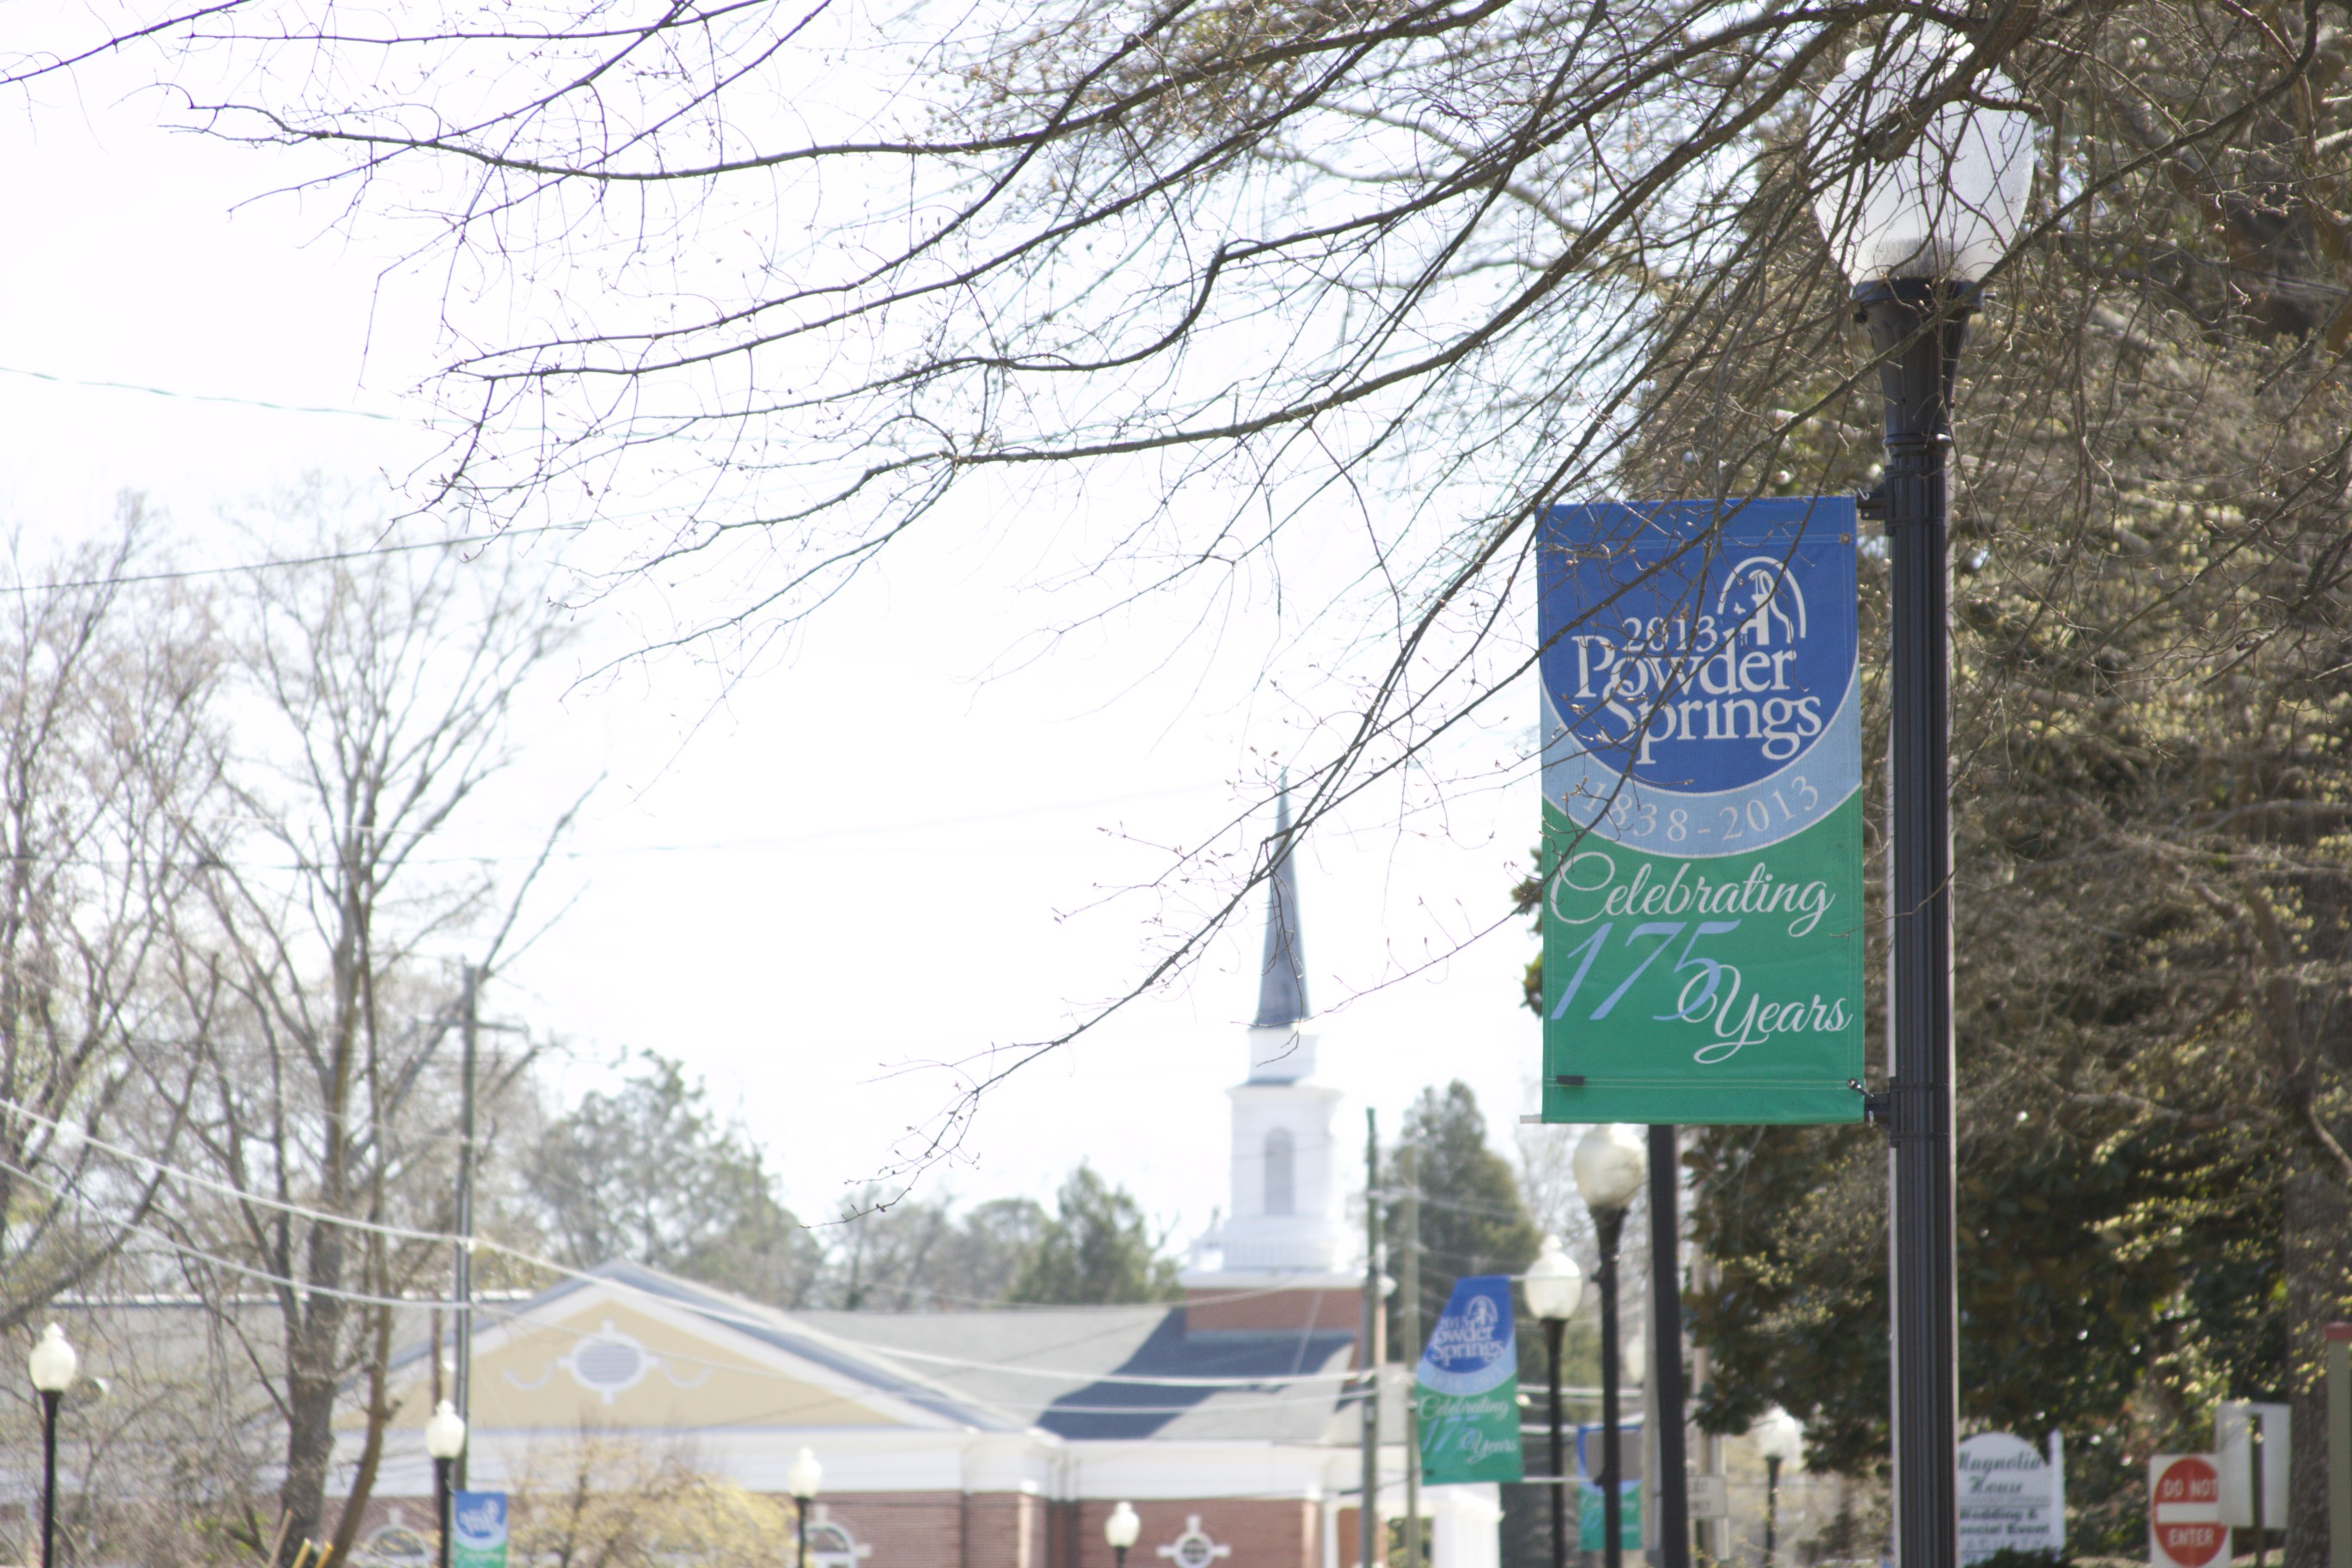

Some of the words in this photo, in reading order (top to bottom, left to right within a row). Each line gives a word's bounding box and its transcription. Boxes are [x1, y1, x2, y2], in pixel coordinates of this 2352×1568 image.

[1622, 615, 1719, 653] 2013
[1571, 626, 1798, 700] Powder
[1600, 677, 1822, 764] Springs
[1582, 775, 1820, 842] 1838-2013
[1550, 851, 1836, 938] Celebrating
[1550, 918, 1743, 1021] 175
[1677, 964, 1854, 1064] Years
[1434, 1321, 1496, 1343] owder
[1430, 1340, 1505, 1367] Springs
[1418, 1395, 1510, 1421] Celebrating
[1459, 1428, 1518, 1465] Years
[2162, 1478, 2184, 1499] DO
[2189, 1478, 2218, 1498] NOT
[2168, 1528, 2214, 1547] ENTER
